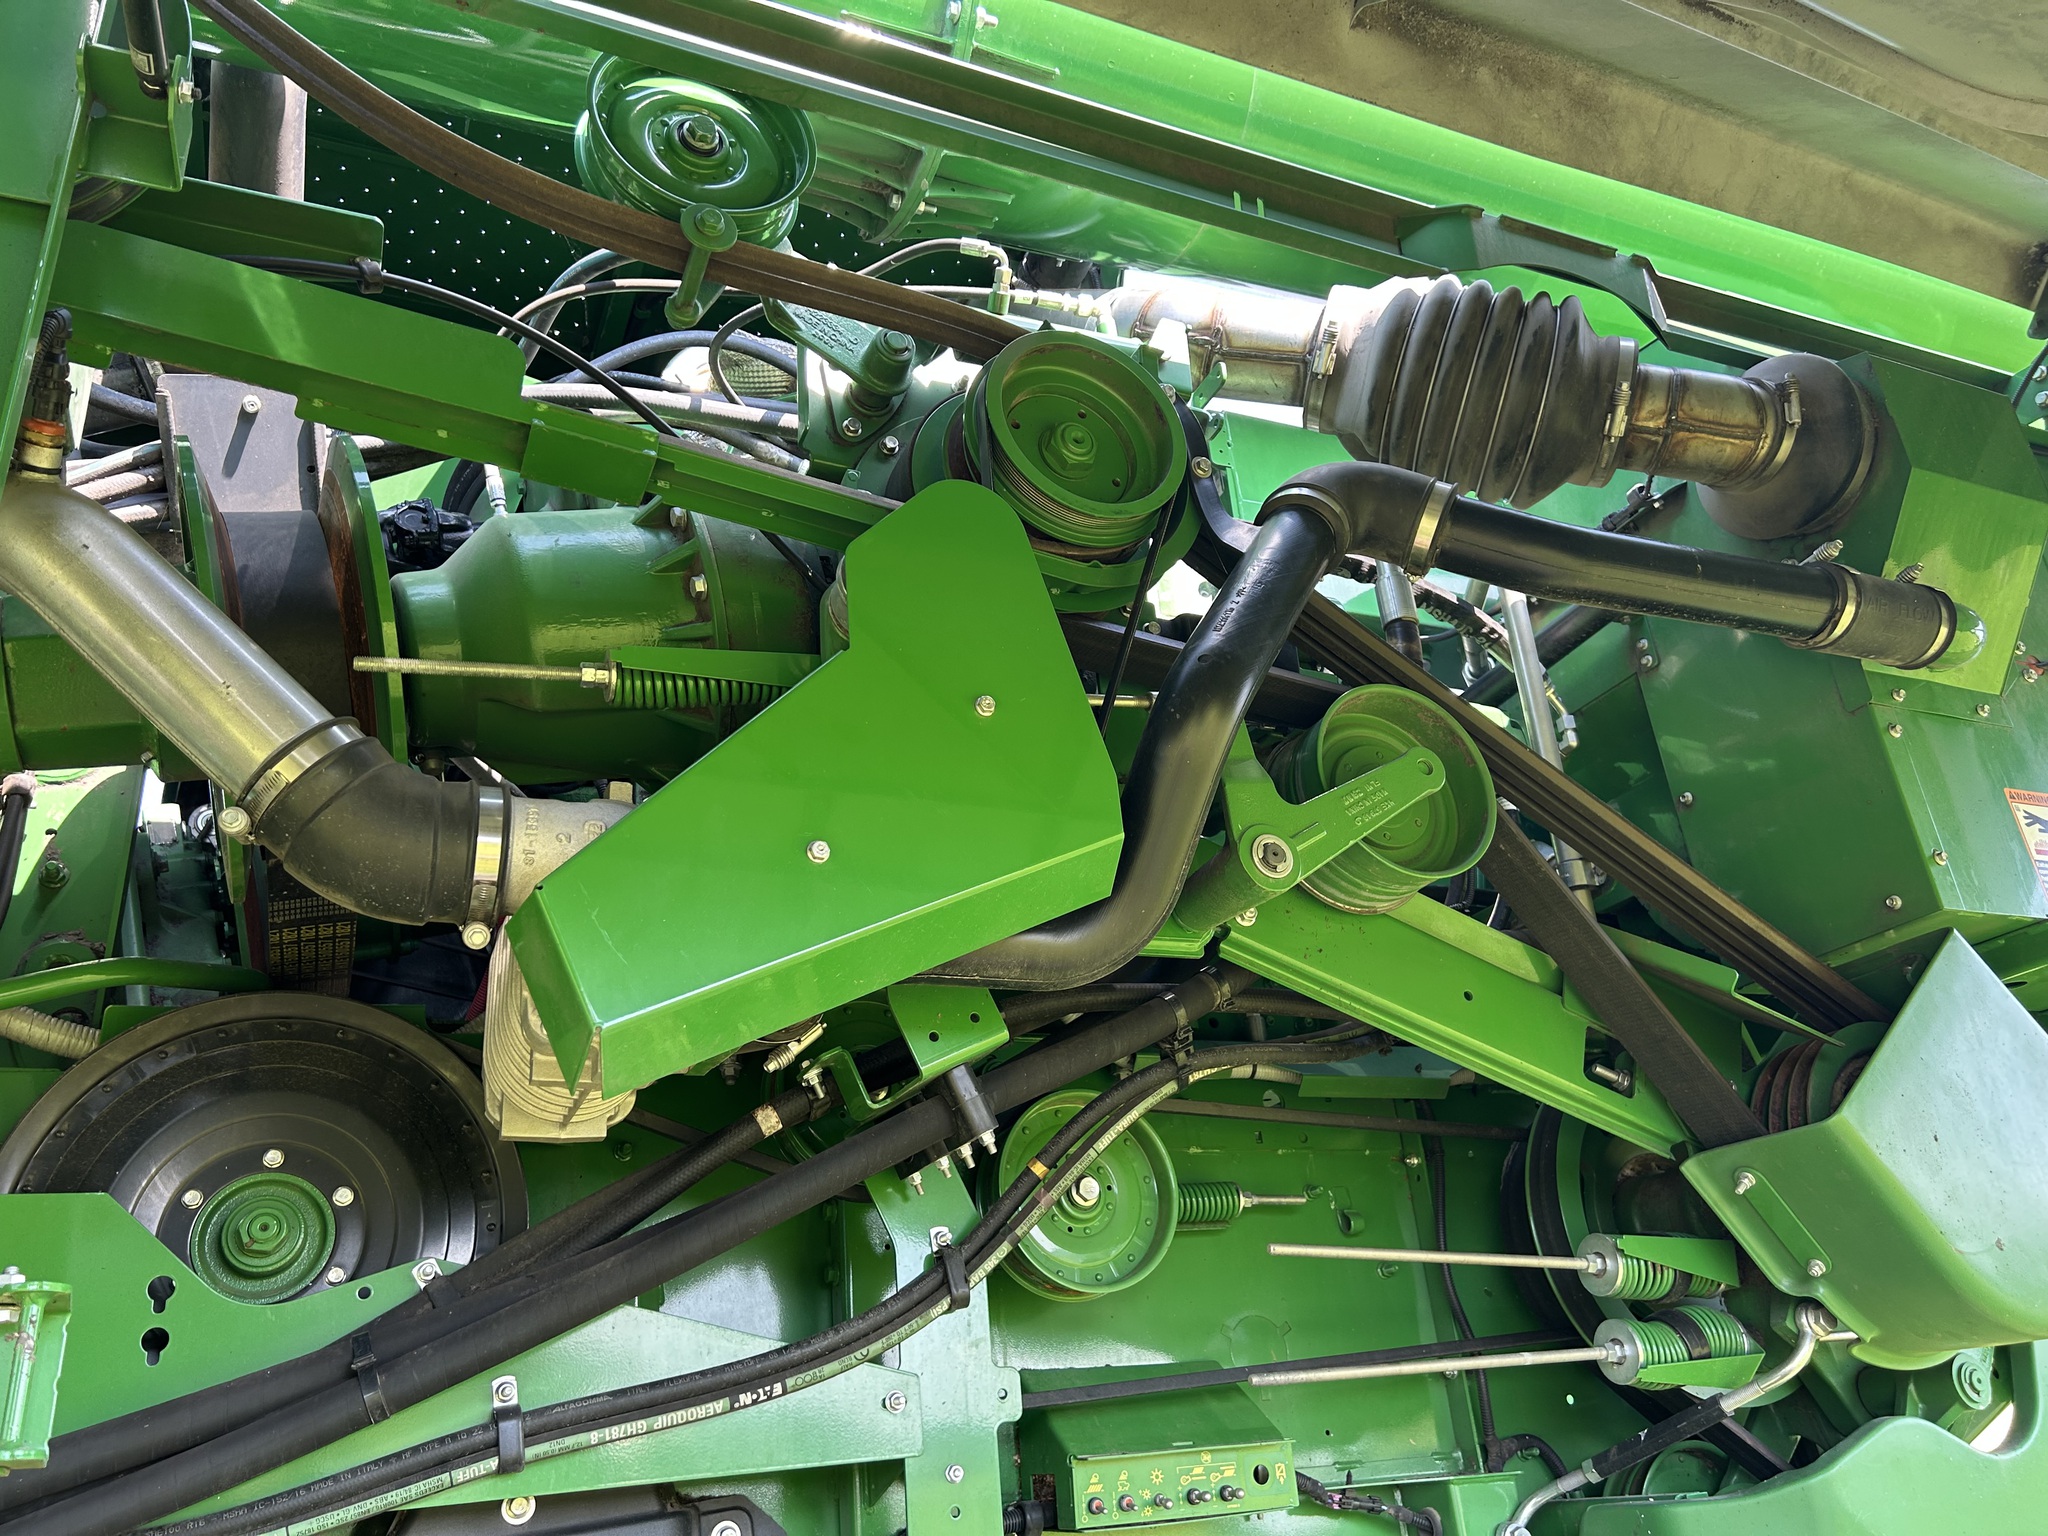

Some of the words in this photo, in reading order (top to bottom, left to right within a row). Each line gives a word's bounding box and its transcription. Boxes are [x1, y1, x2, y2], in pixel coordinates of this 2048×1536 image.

[1866, 596, 1889, 613] AIR
[1895, 601, 1935, 625] FLOW
[1094, 1109, 1140, 1151] DURA-TUFF
[982, 1255, 999, 1272] 345
[928, 1300, 947, 1317] PSI)
[652, 1403, 725, 1429] AEROQUIP
[589, 1421, 648, 1445] GH781-8
[547, 1438, 565, 1448] DN12
[309, 1477, 335, 1492] MADE
[338, 1471, 352, 1482] IN
[418, 1440, 441, 1453] TYPE
[470, 1426, 484, 1436] 22
[422, 1476, 443, 1488] MSHA
[351, 1501, 368, 1511] DNV
[373, 1494, 389, 1504] ABS
[314, 1512, 335, 1524] USCG
[341, 1507, 350, 1515] GL
[315, 1521, 329, 1530] ISO
